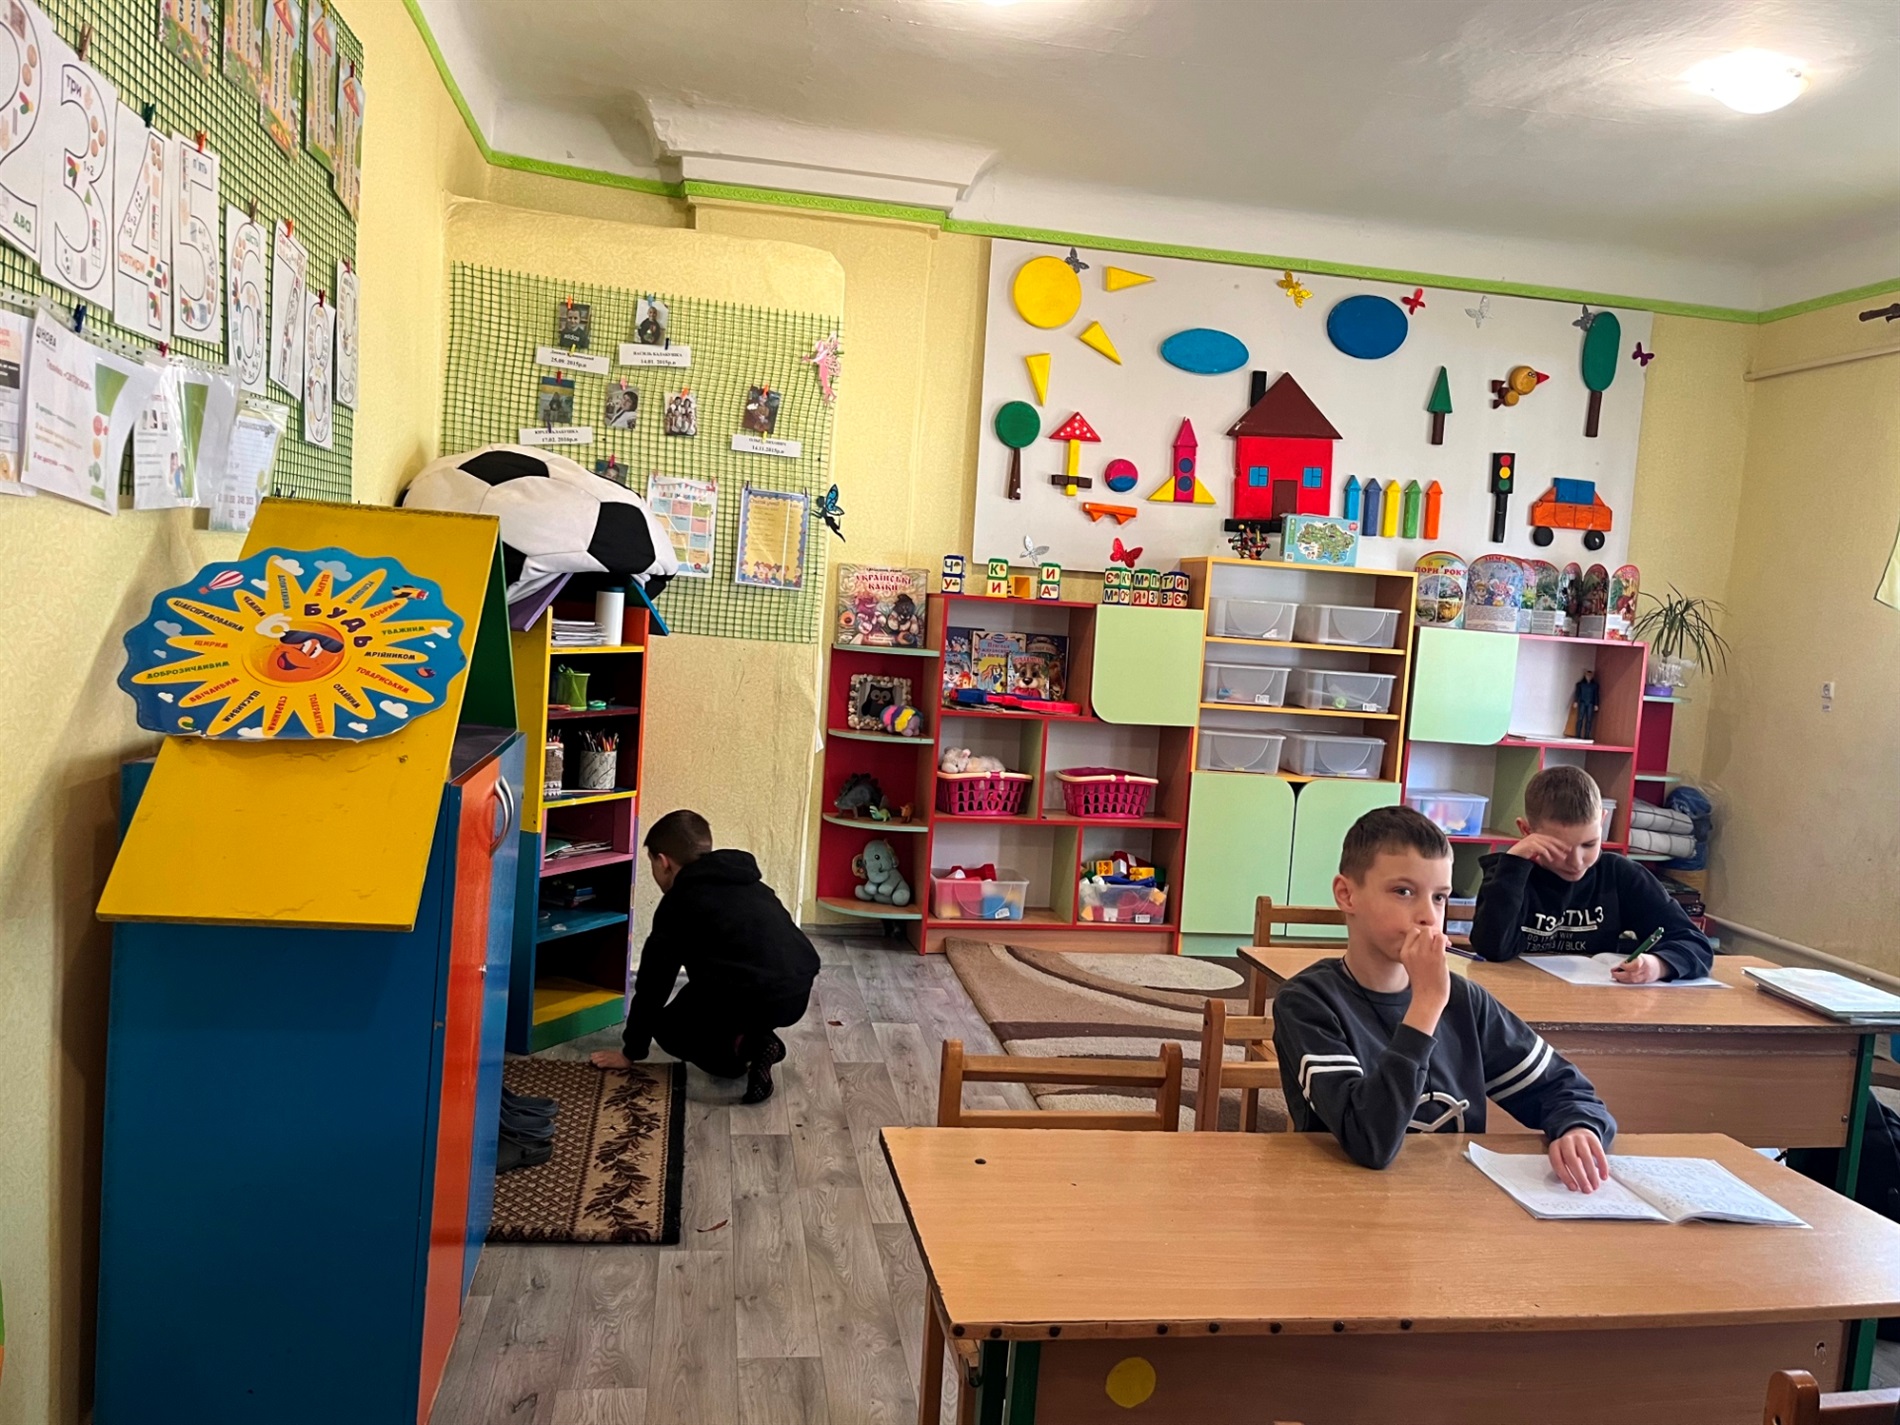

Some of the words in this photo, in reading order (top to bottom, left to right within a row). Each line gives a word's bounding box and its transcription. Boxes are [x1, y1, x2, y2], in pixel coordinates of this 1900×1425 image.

[66, 74, 82, 98] три
[55, 64, 108, 289] 3
[118, 132, 169, 331] 4
[180, 141, 218, 331] 5
[230, 222, 264, 385] 6
[277, 228, 306, 387] 7
[338, 271, 357, 404] 9
[308, 302, 330, 443] 8
[944, 560, 954, 572] Ч
[990, 564, 999, 575] К
[1046, 568, 1055, 579] И
[944, 579, 953, 590] У
[1105, 572, 1114, 584] Є
[1121, 574, 1127, 584] К
[1135, 574, 1144, 585] М
[992, 582, 1001, 593] И
[1042, 585, 1052, 596] А
[1104, 590, 1114, 601] М
[1162, 593, 1168, 604] В
[1174, 593, 1182, 604] Є
[369, 601, 400, 619] ДОБРИМ
[304, 603, 373, 648] БУДЬ
[381, 625, 426, 636] УВАЖНИМ
[194, 640, 229, 649] ЩИРИМ
[364, 651, 416, 660] МРІЙНИКОМ
[146, 660, 230, 679] ДОБРОЗИЧЛИВИМ
[355, 667, 409, 694] ТОВАРИСЬКИМ
[189, 677, 240, 703] ВВІЧЛИВИМ
[333, 683, 361, 709] ОХАЙНИМ
[222, 690, 261, 723] ЩАСЛИВИМ
[267, 696, 288, 731] СТАРАННИМ
[308, 693, 326, 734] ТОЛЕРАНТНИМ
[1565, 941, 1587, 951] BLCK
